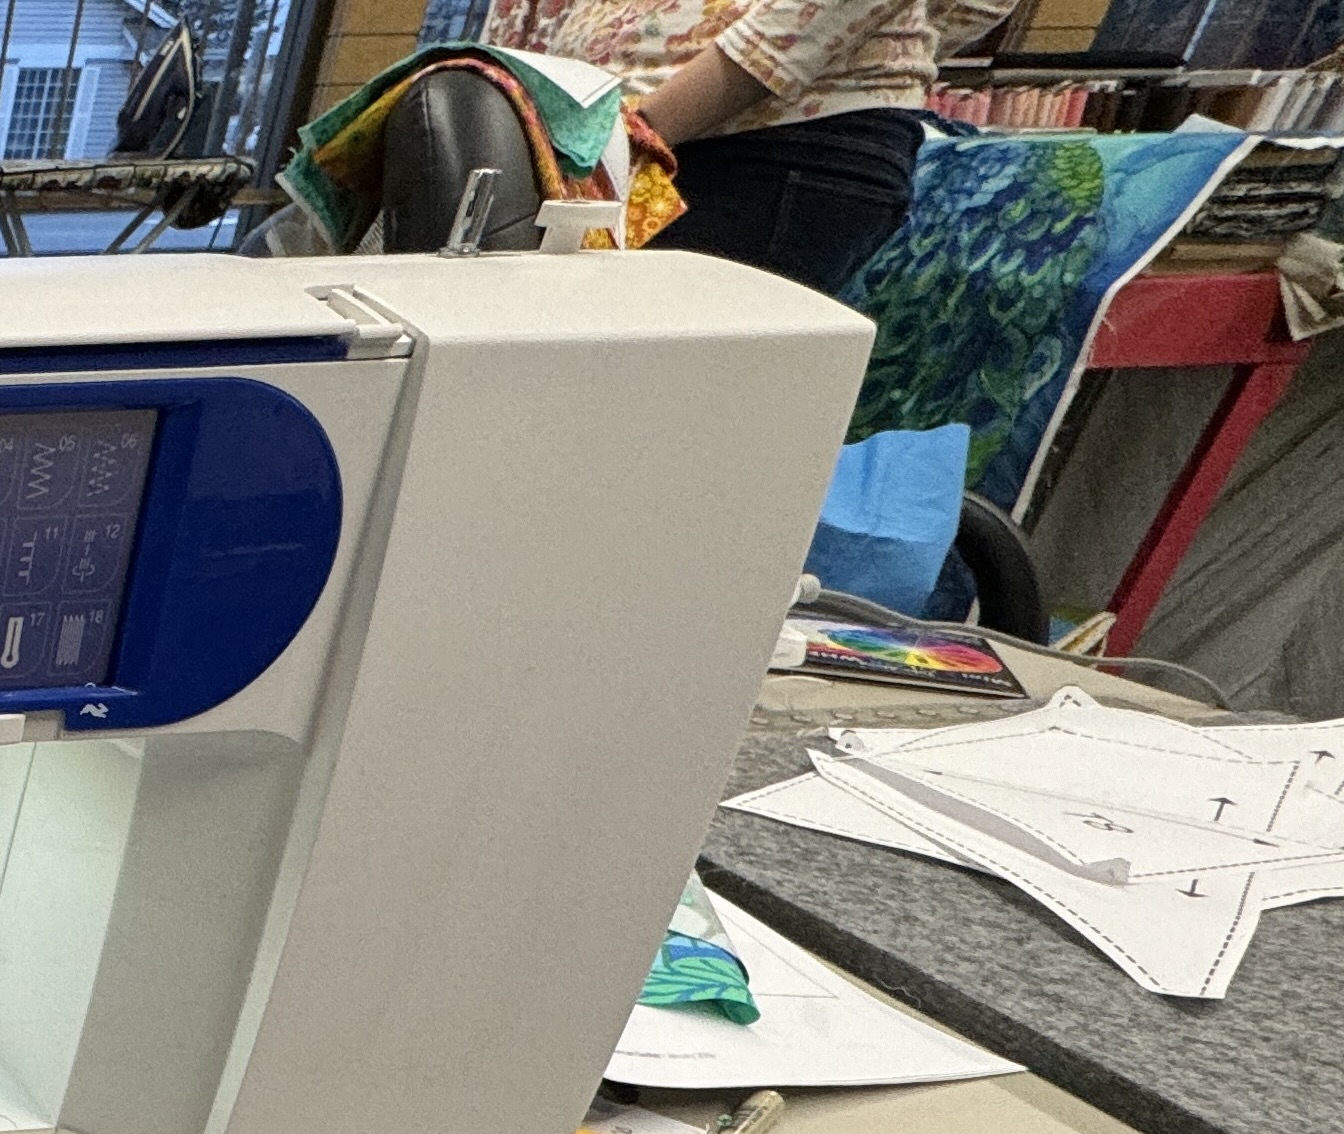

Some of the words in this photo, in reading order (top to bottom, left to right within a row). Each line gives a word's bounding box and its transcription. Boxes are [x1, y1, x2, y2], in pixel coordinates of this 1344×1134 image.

[59, 435, 76, 451] 05
[45, 526, 60, 541] 11
[105, 524, 121, 540] 12
[30, 612, 46, 628] 17
[89, 609, 104, 625] 18
